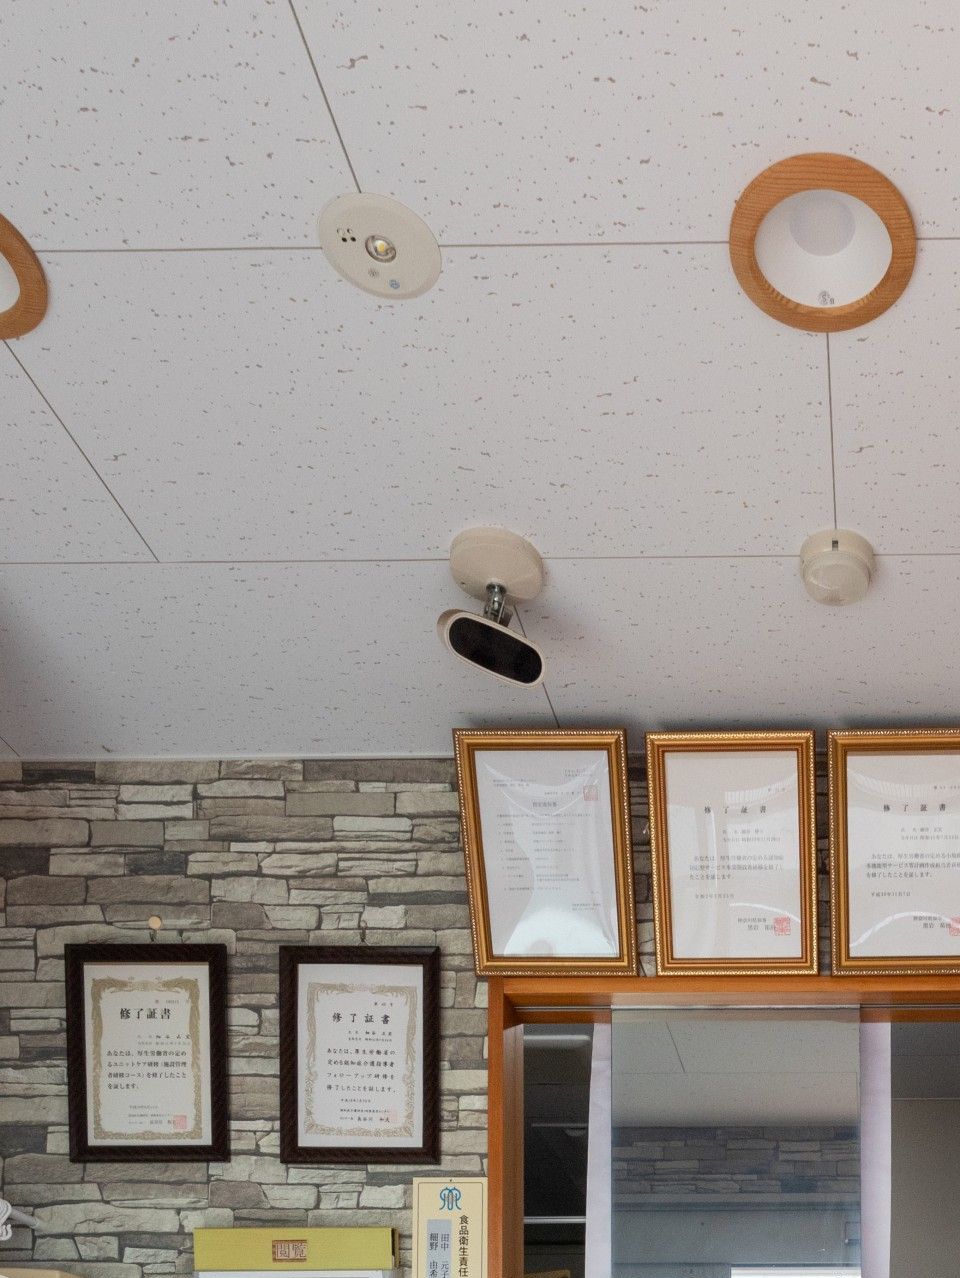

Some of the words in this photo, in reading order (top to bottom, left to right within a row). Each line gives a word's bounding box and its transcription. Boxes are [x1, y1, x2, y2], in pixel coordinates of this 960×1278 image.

[704, 805, 766, 814] 修了証書
[883, 803, 946, 812] 修了証書
[120, 1008, 171, 1019] 修了証書
[332, 1012, 390, 1024] 修了証書
[429, 1233, 439, 1251] 細野
[440, 1233, 450, 1251] 田中
[275, 1242, 307, 1258] 閲覧
